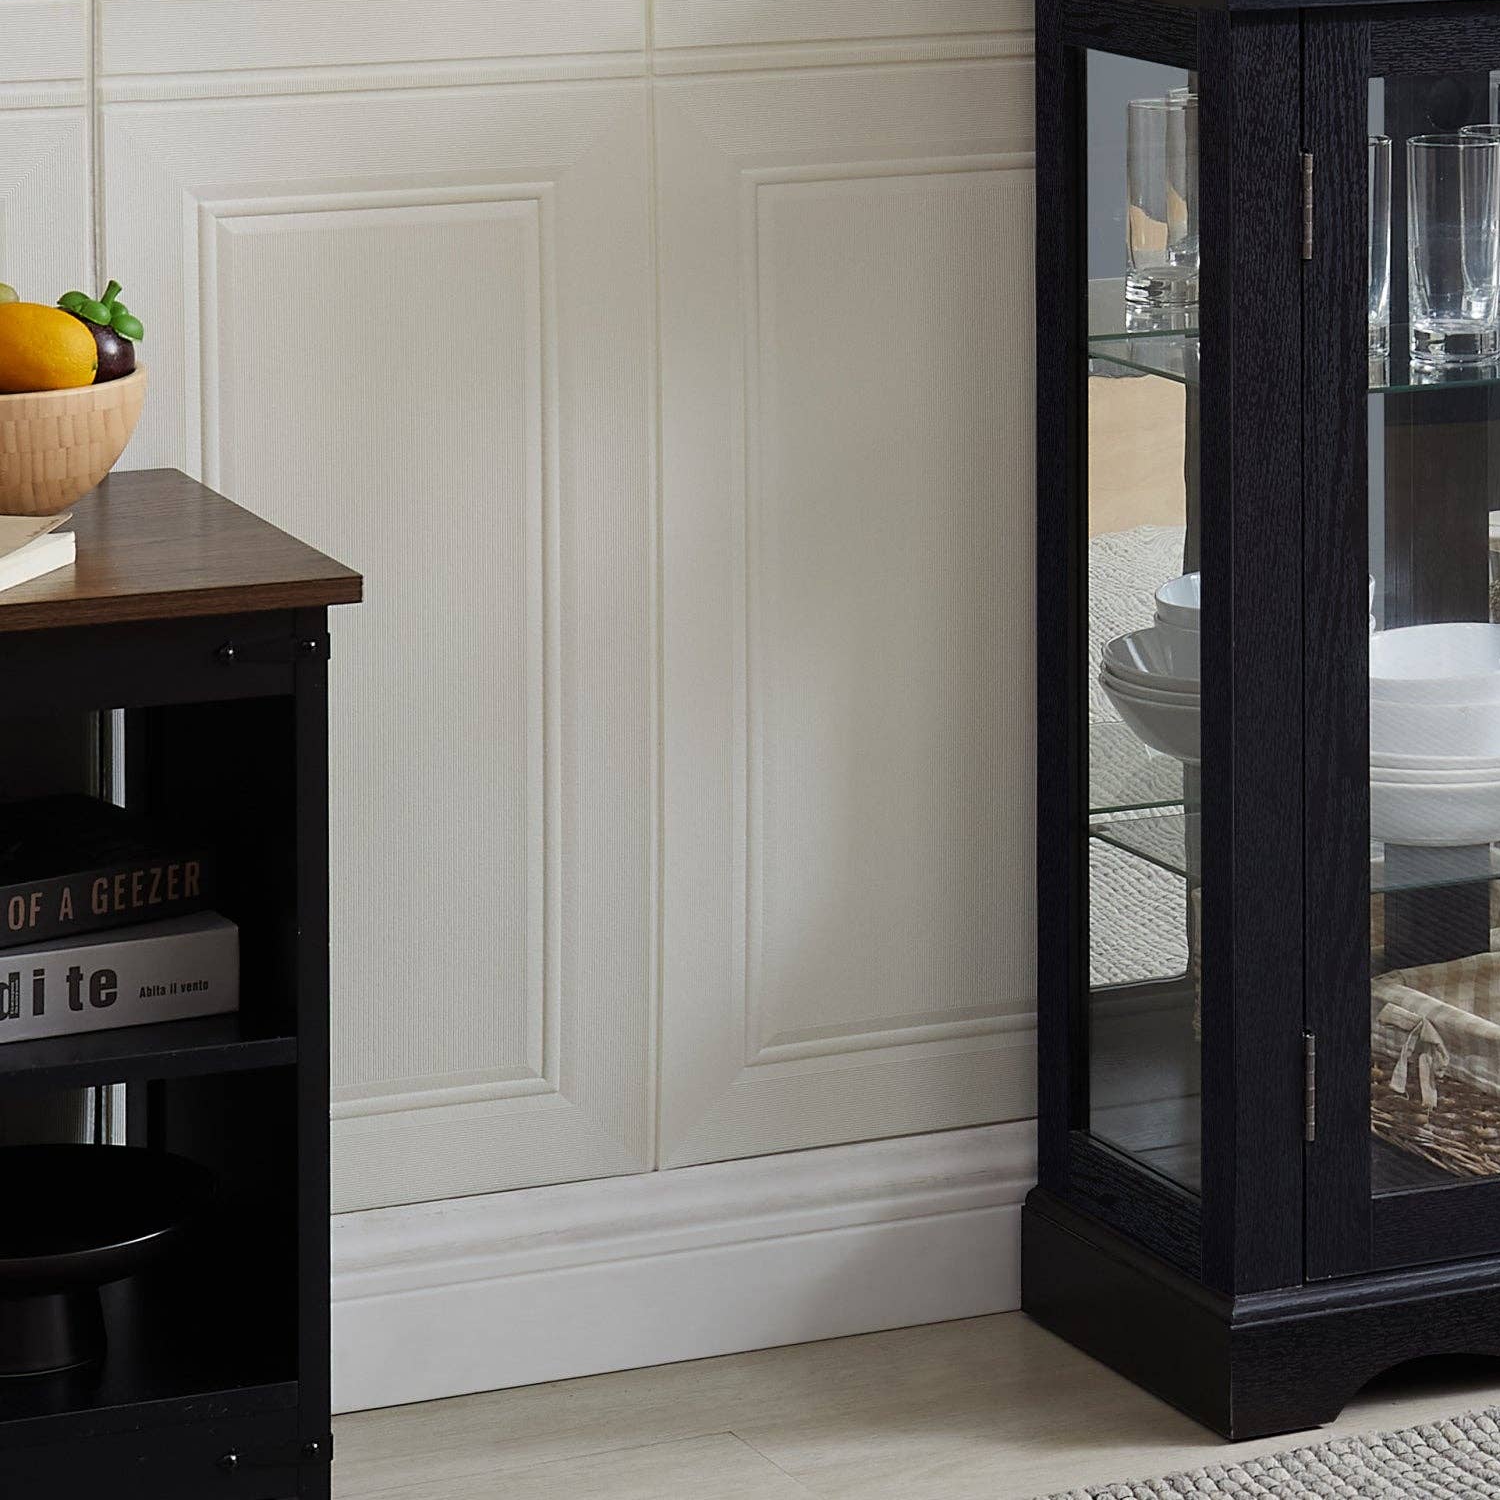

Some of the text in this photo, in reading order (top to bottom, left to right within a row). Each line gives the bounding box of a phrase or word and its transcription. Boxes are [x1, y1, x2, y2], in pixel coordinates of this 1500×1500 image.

[8, 861, 200, 931] OF A GEEZER
[180, 979, 209, 993] vento
